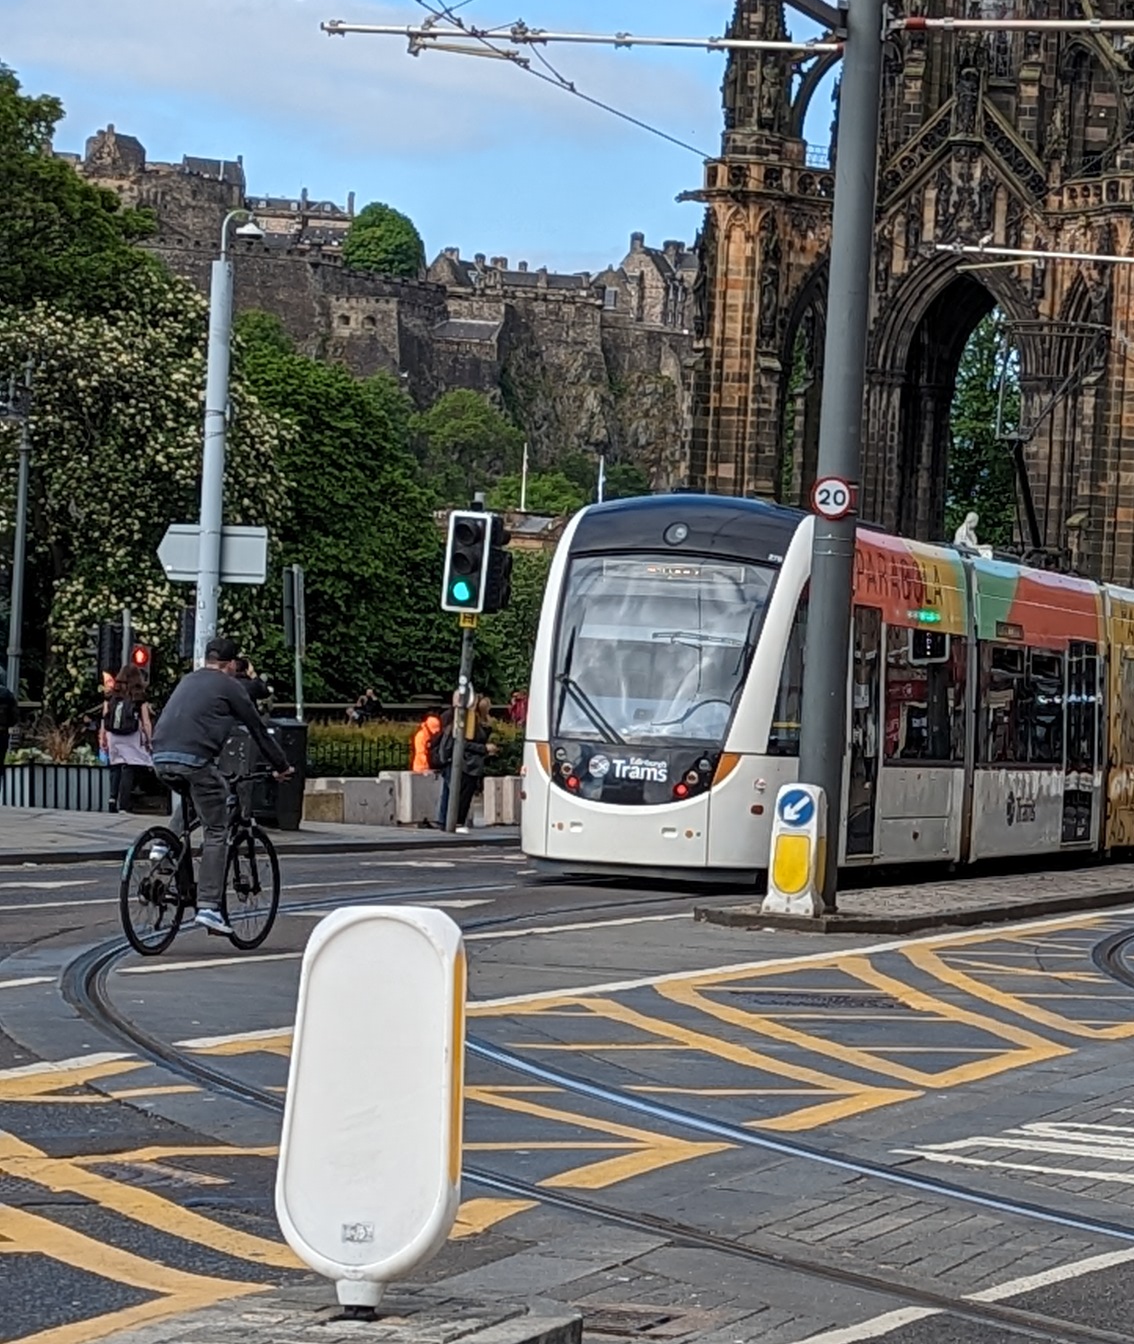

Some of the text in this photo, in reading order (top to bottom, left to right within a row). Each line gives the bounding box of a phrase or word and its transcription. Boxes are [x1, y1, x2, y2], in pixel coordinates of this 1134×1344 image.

[818, 488, 846, 506] 20
[612, 759, 668, 783] Trams
[629, 757, 668, 768] Edinburgh
